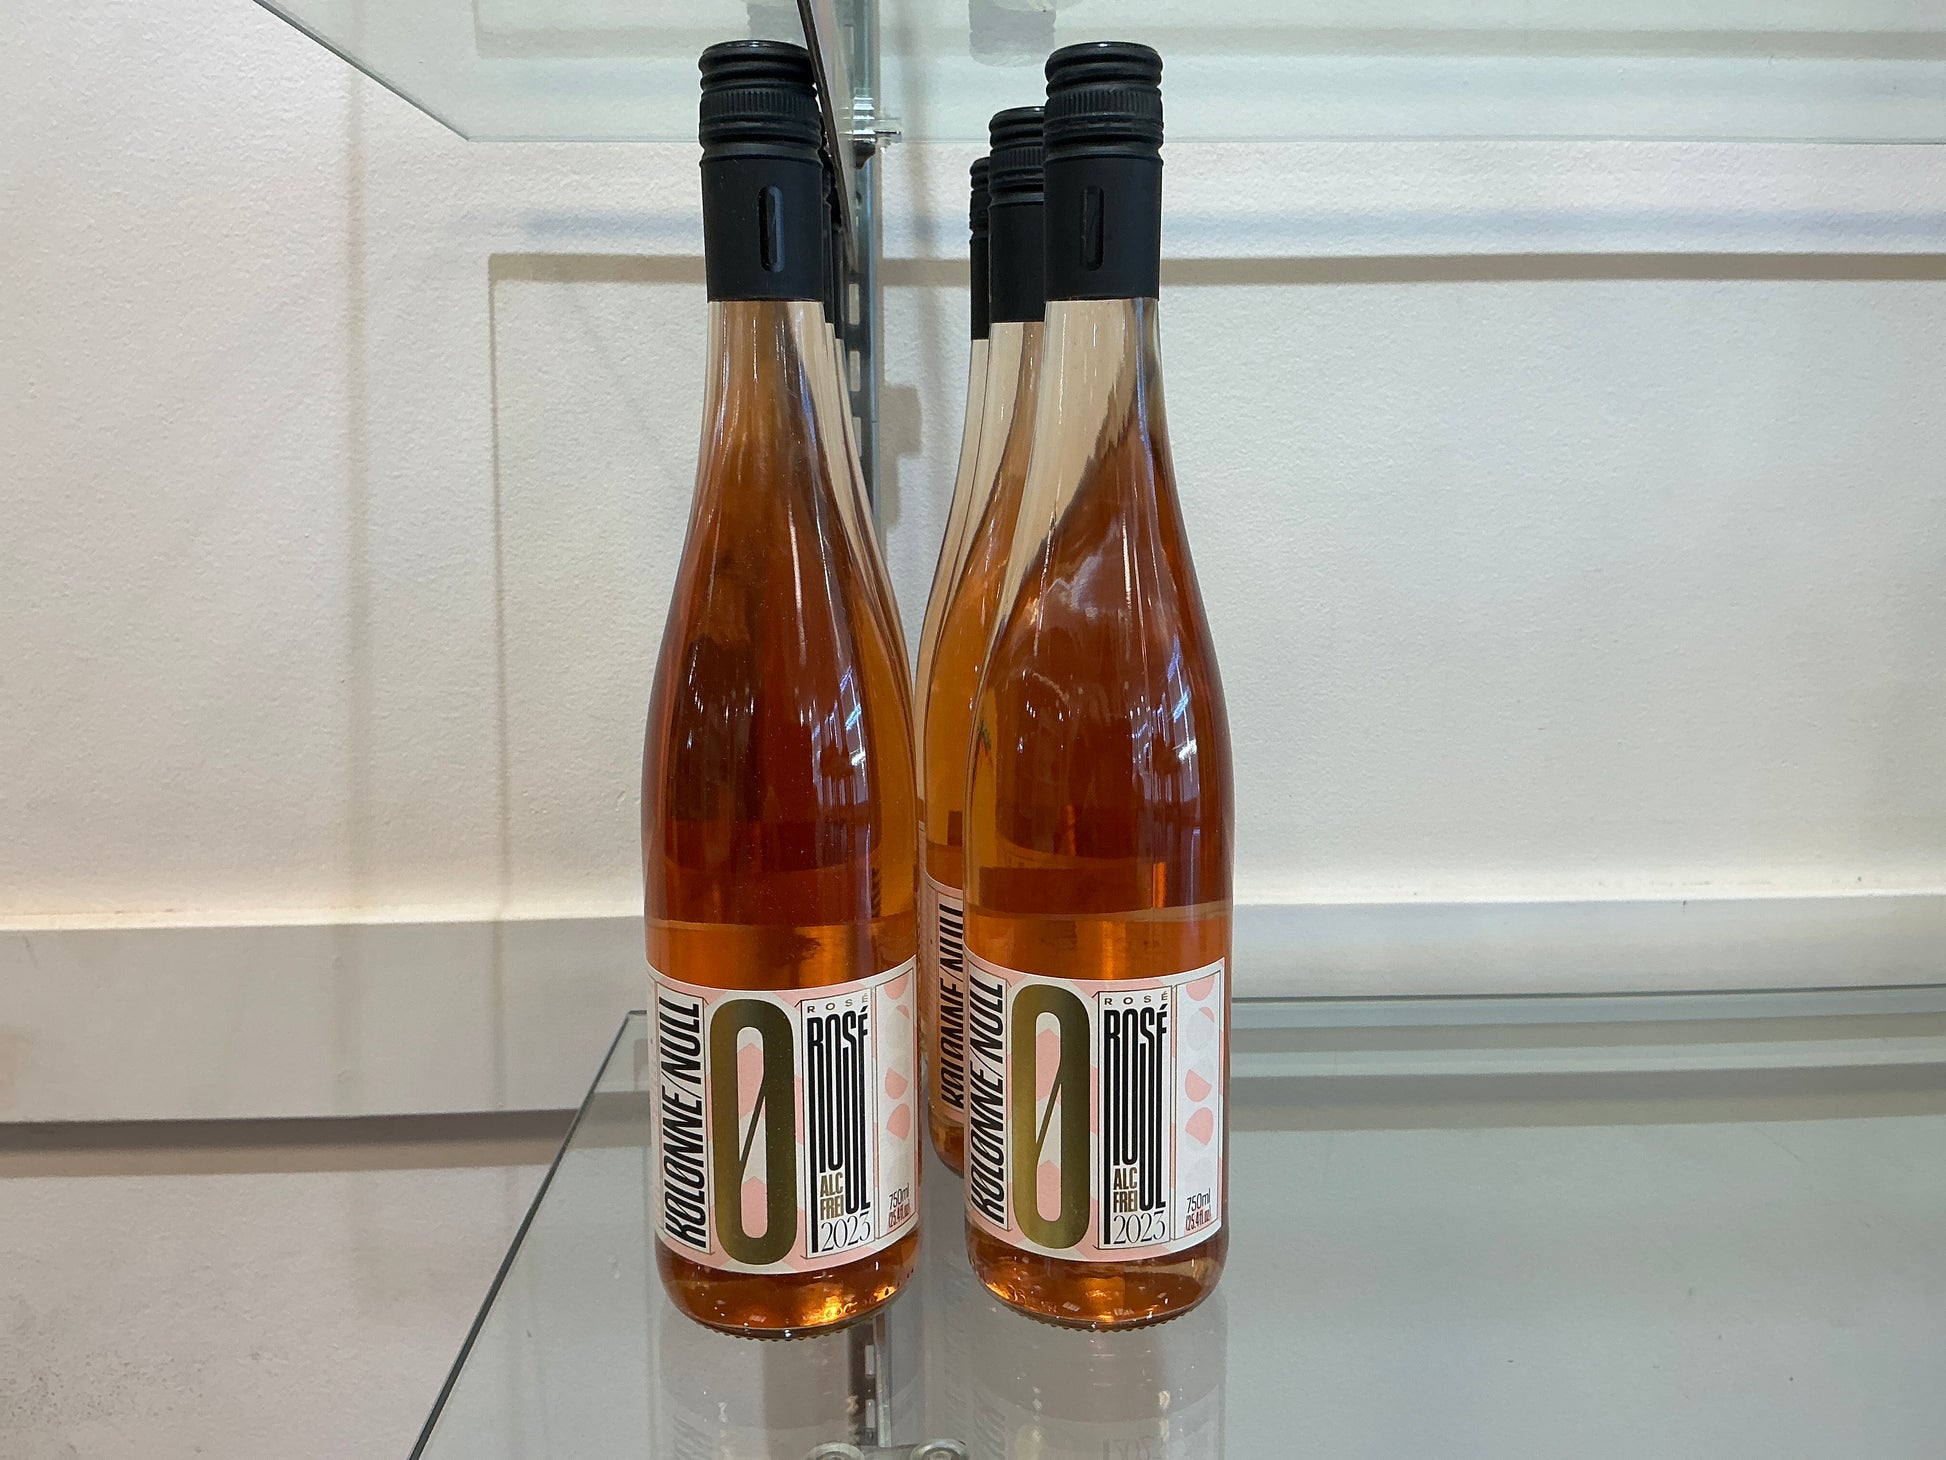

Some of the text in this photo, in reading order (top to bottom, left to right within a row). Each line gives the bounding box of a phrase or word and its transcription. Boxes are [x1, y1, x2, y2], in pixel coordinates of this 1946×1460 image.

[807, 993, 869, 1014] ROSÉ
[1104, 990, 1168, 1006] ROSÉ
[807, 1005, 871, 1253] ROSÉ
[1103, 1003, 1168, 1245] ROSÉ
[820, 1172, 844, 1197] ALC
[1113, 1167, 1138, 1190] ALC
[820, 1195, 845, 1221] FREI
[889, 1182, 910, 1210] 750ml
[1113, 1190, 1138, 1213] FREI
[1186, 1188, 1211, 1213] 750ml
[821, 1211, 871, 1252] 2023
[1113, 1210, 1166, 1245] 2023
